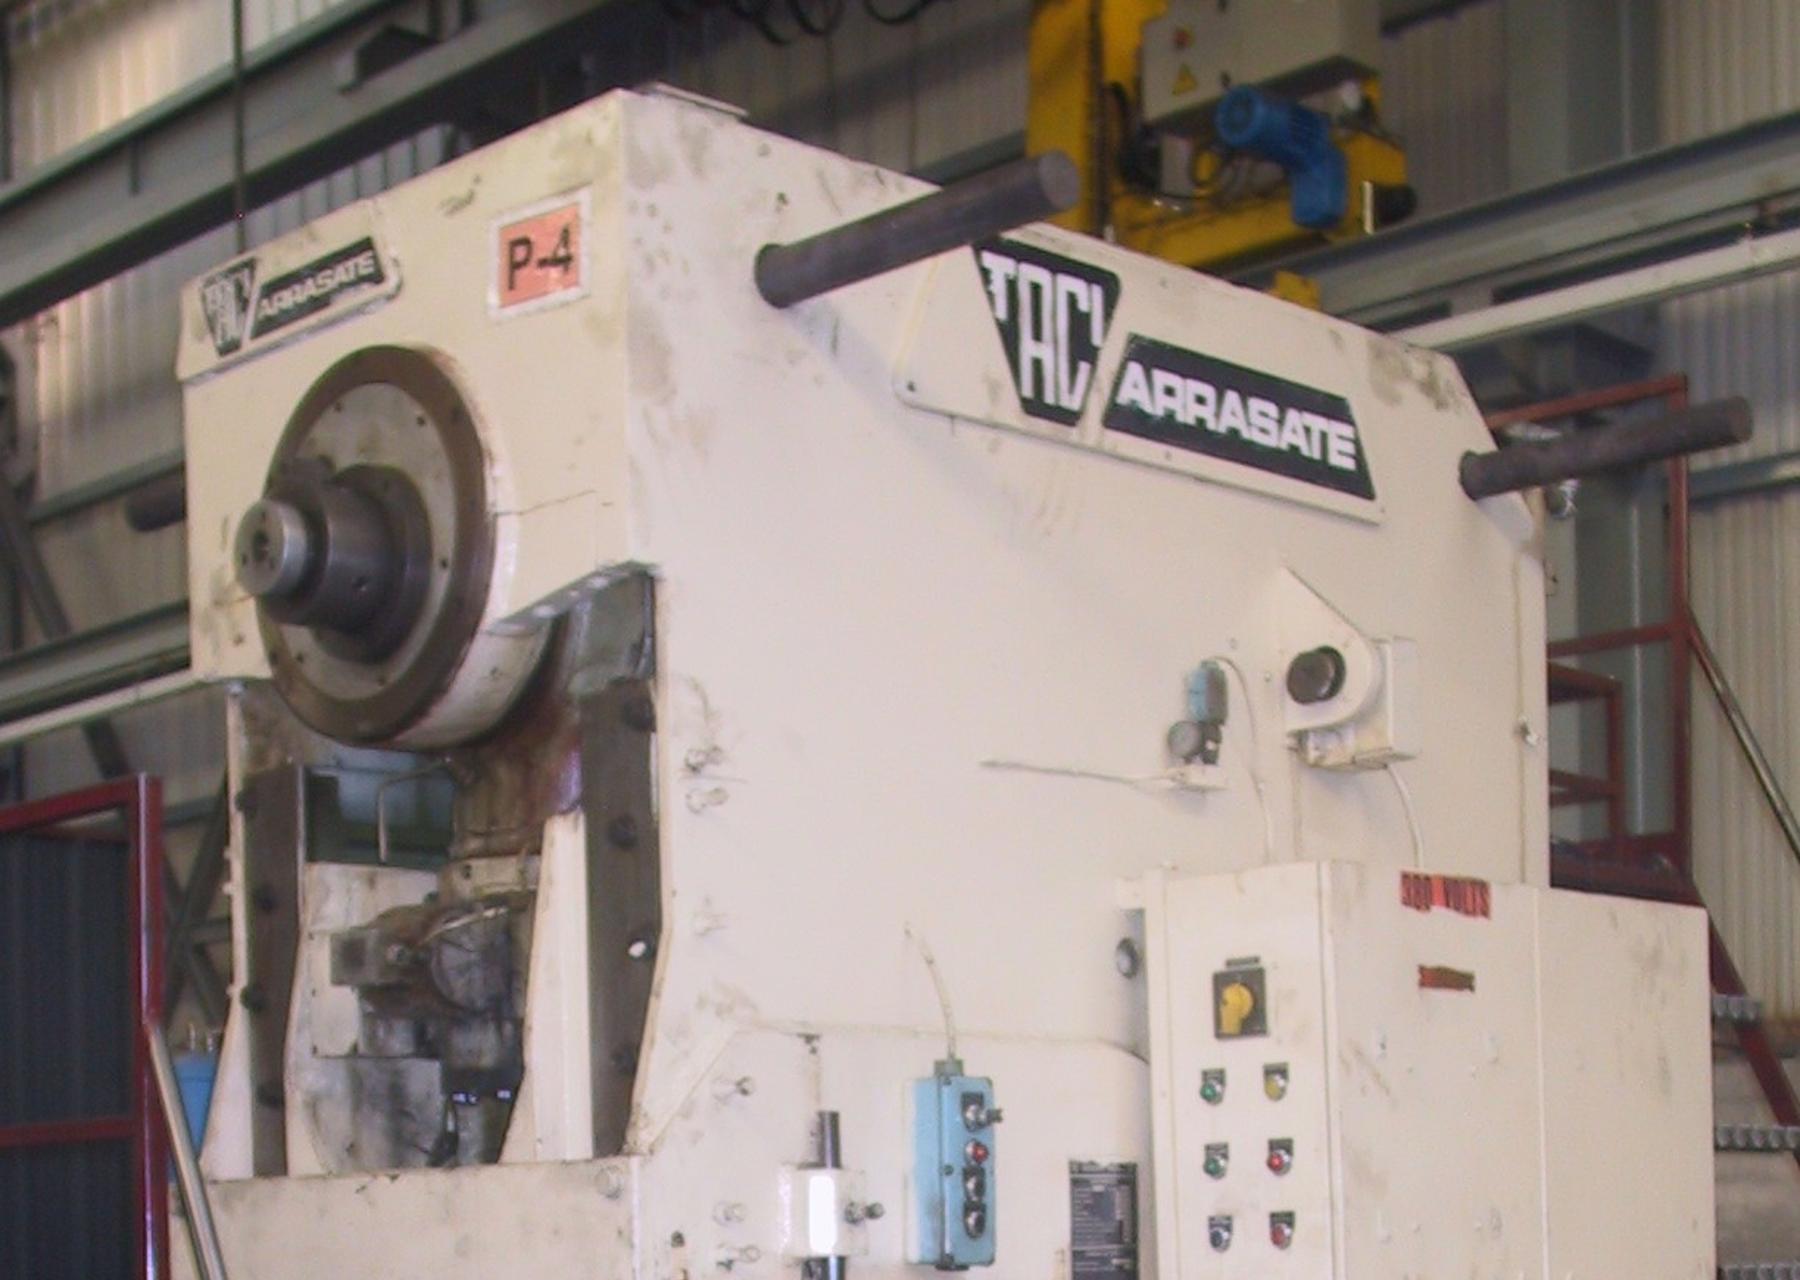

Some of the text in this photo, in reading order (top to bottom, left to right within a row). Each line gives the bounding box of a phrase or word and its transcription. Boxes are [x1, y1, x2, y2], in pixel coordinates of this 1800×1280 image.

[256, 251, 377, 320] ARRASATE
[508, 225, 573, 290] P-4
[1115, 360, 1358, 472] ARRASATE
